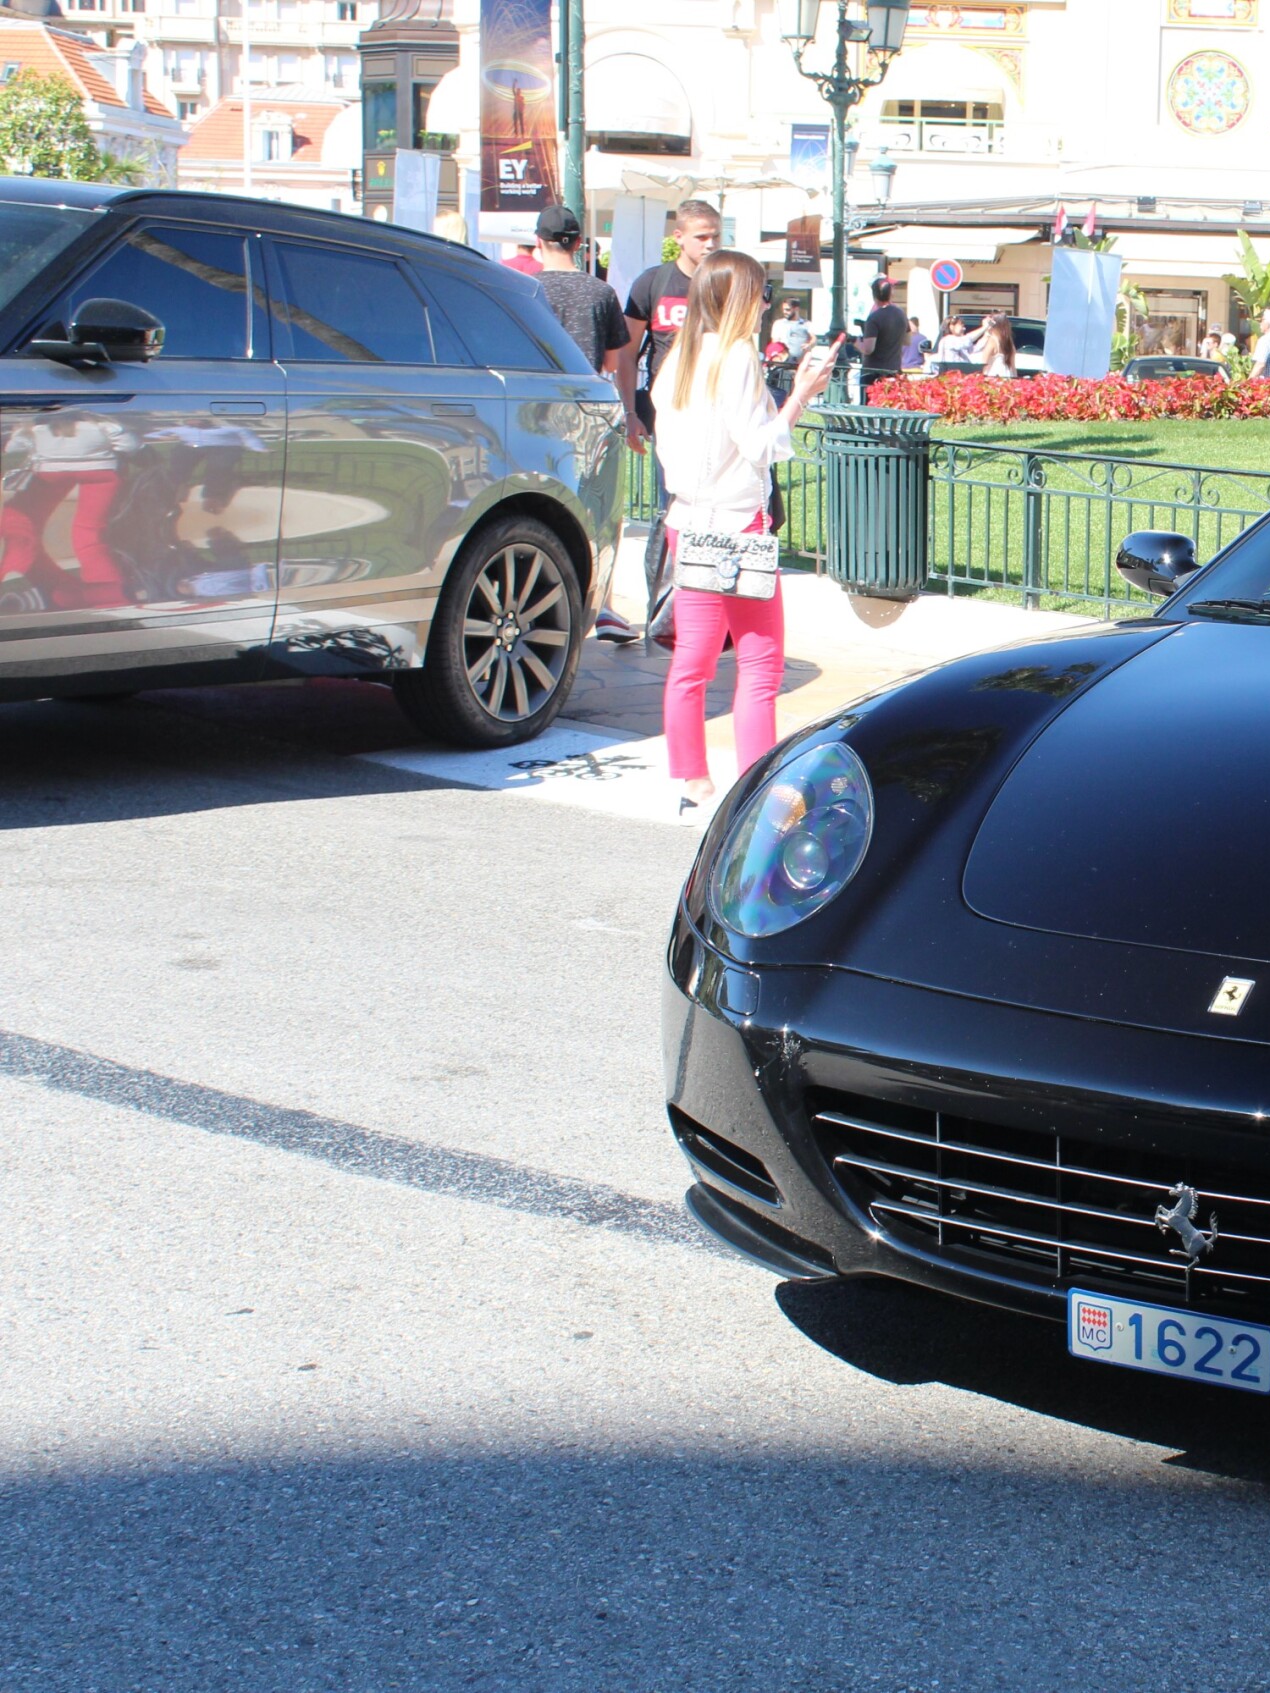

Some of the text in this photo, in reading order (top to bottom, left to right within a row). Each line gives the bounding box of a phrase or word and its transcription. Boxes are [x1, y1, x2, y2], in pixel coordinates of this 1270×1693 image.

[499, 159, 528, 179] EY
[683, 533, 739, 555] Wildly
[1081, 1325, 1107, 1343] MC
[1128, 1312, 1261, 1384] 1622
